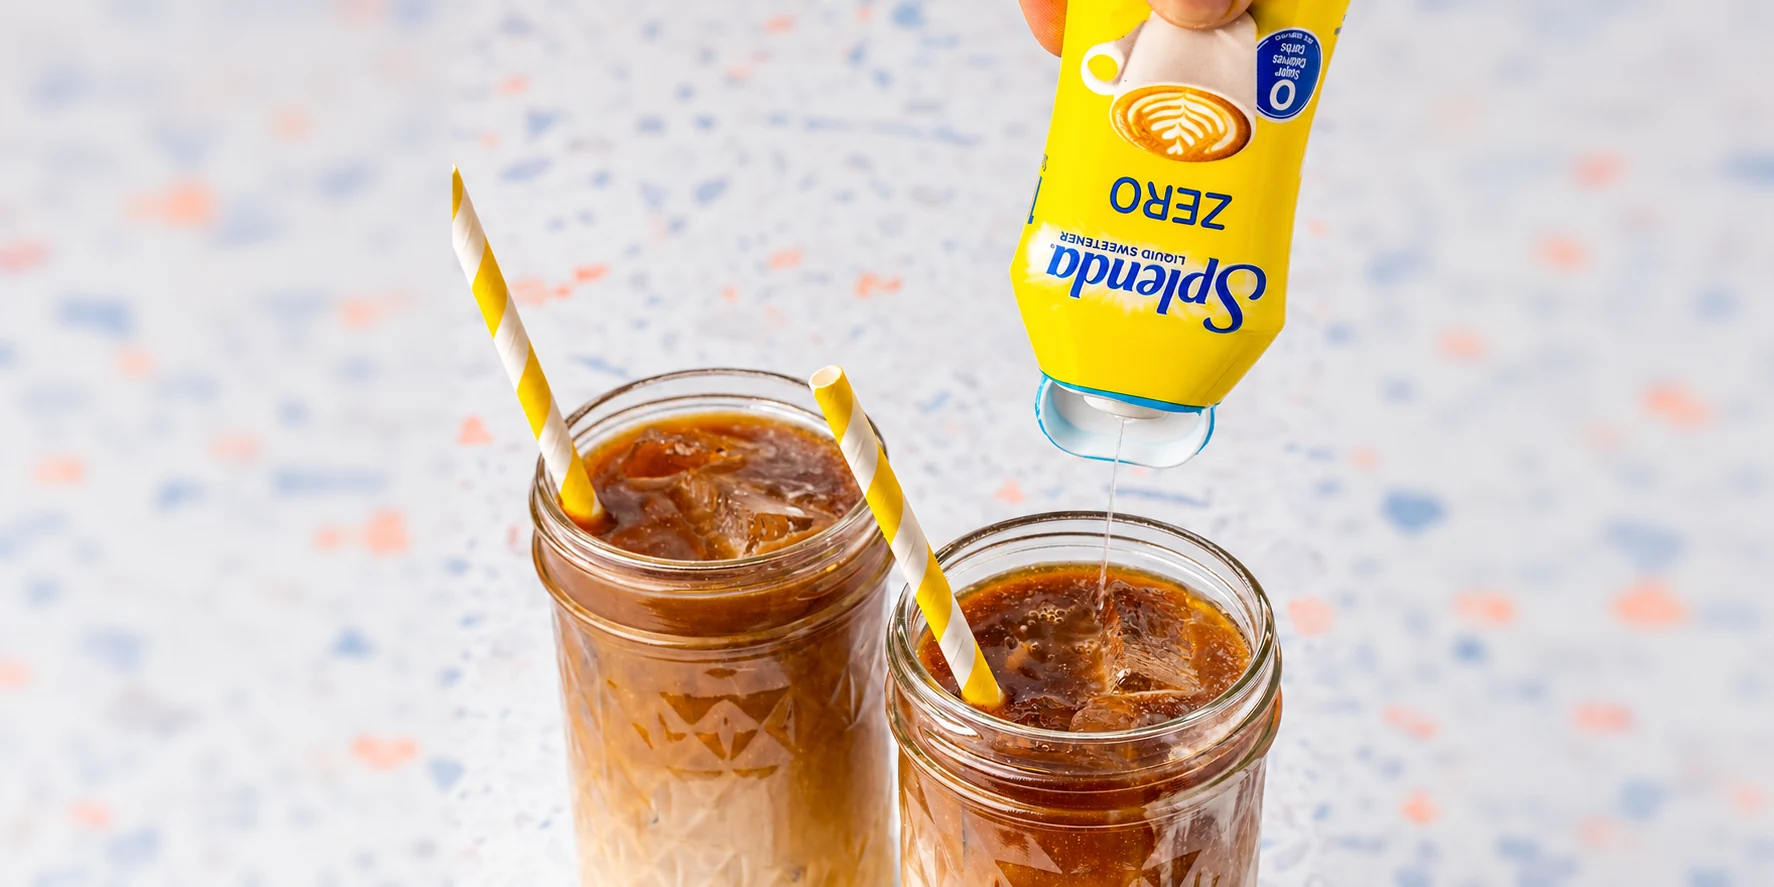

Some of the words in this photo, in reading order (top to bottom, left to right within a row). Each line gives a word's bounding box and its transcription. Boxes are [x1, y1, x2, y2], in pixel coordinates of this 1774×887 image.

[1269, 79, 1296, 111] 0
[1109, 176, 1233, 231] ZERO
[1059, 231, 1138, 257] SWEETENER
[1141, 249, 1186, 265] LIQUID
[1046, 244, 1267, 334] Splenda
